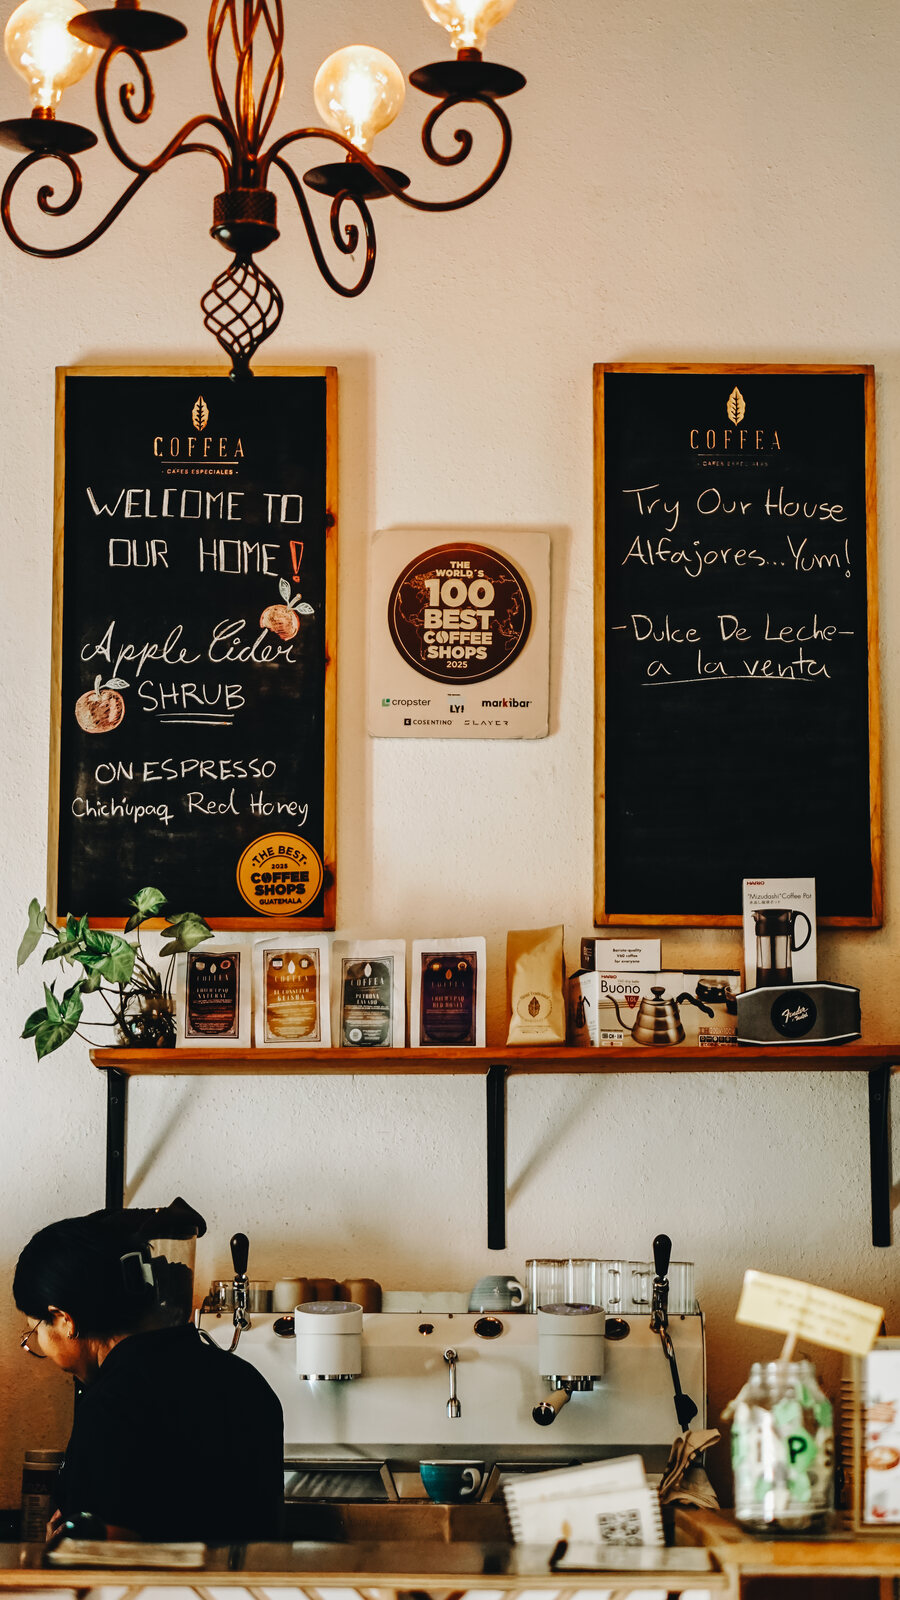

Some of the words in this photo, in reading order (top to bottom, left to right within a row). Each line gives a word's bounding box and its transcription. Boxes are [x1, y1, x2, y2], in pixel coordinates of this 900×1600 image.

[153, 436, 245, 458] COFFEA
[689, 429, 781, 450] COFFEA
[191, 468, 233, 476] ESPECIALES
[86, 486, 245, 521] WELCOME
[263, 493, 303, 524] TO
[622, 483, 680, 532] Try
[696, 487, 752, 515] Our
[764, 486, 848, 522] House
[108, 537, 169, 568] OUR
[199, 537, 304, 583] HOME!
[450, 561, 470, 569] THE
[786, 535, 851, 578] Yum!
[424, 578, 495, 608] 100
[423, 609, 495, 630] BEST
[718, 614, 751, 641] De
[80, 620, 201, 677] Apple
[208, 618, 297, 664] Cider
[423, 631, 493, 645] COFFEE
[427, 645, 488, 660] SHOPS
[446, 660, 468, 669] 2025
[646, 660, 672, 678] a
[697, 649, 728, 675] la
[743, 647, 832, 680] venta
[137, 680, 246, 712] SHRUB
[392, 698, 431, 707] cropster
[482, 698, 530, 708] markibar
[94, 761, 133, 785] ON
[142, 758, 277, 781] ESPRESSO
[187, 788, 240, 816] Red
[250, 790, 309, 827] Honey
[252, 846, 275, 864] THE
[278, 846, 307, 862] BEST
[250, 871, 309, 884] COFFEE
[254, 883, 306, 896] SHOPS
[259, 897, 302, 905] GUATEMALA
[600, 980, 641, 994] Buono
